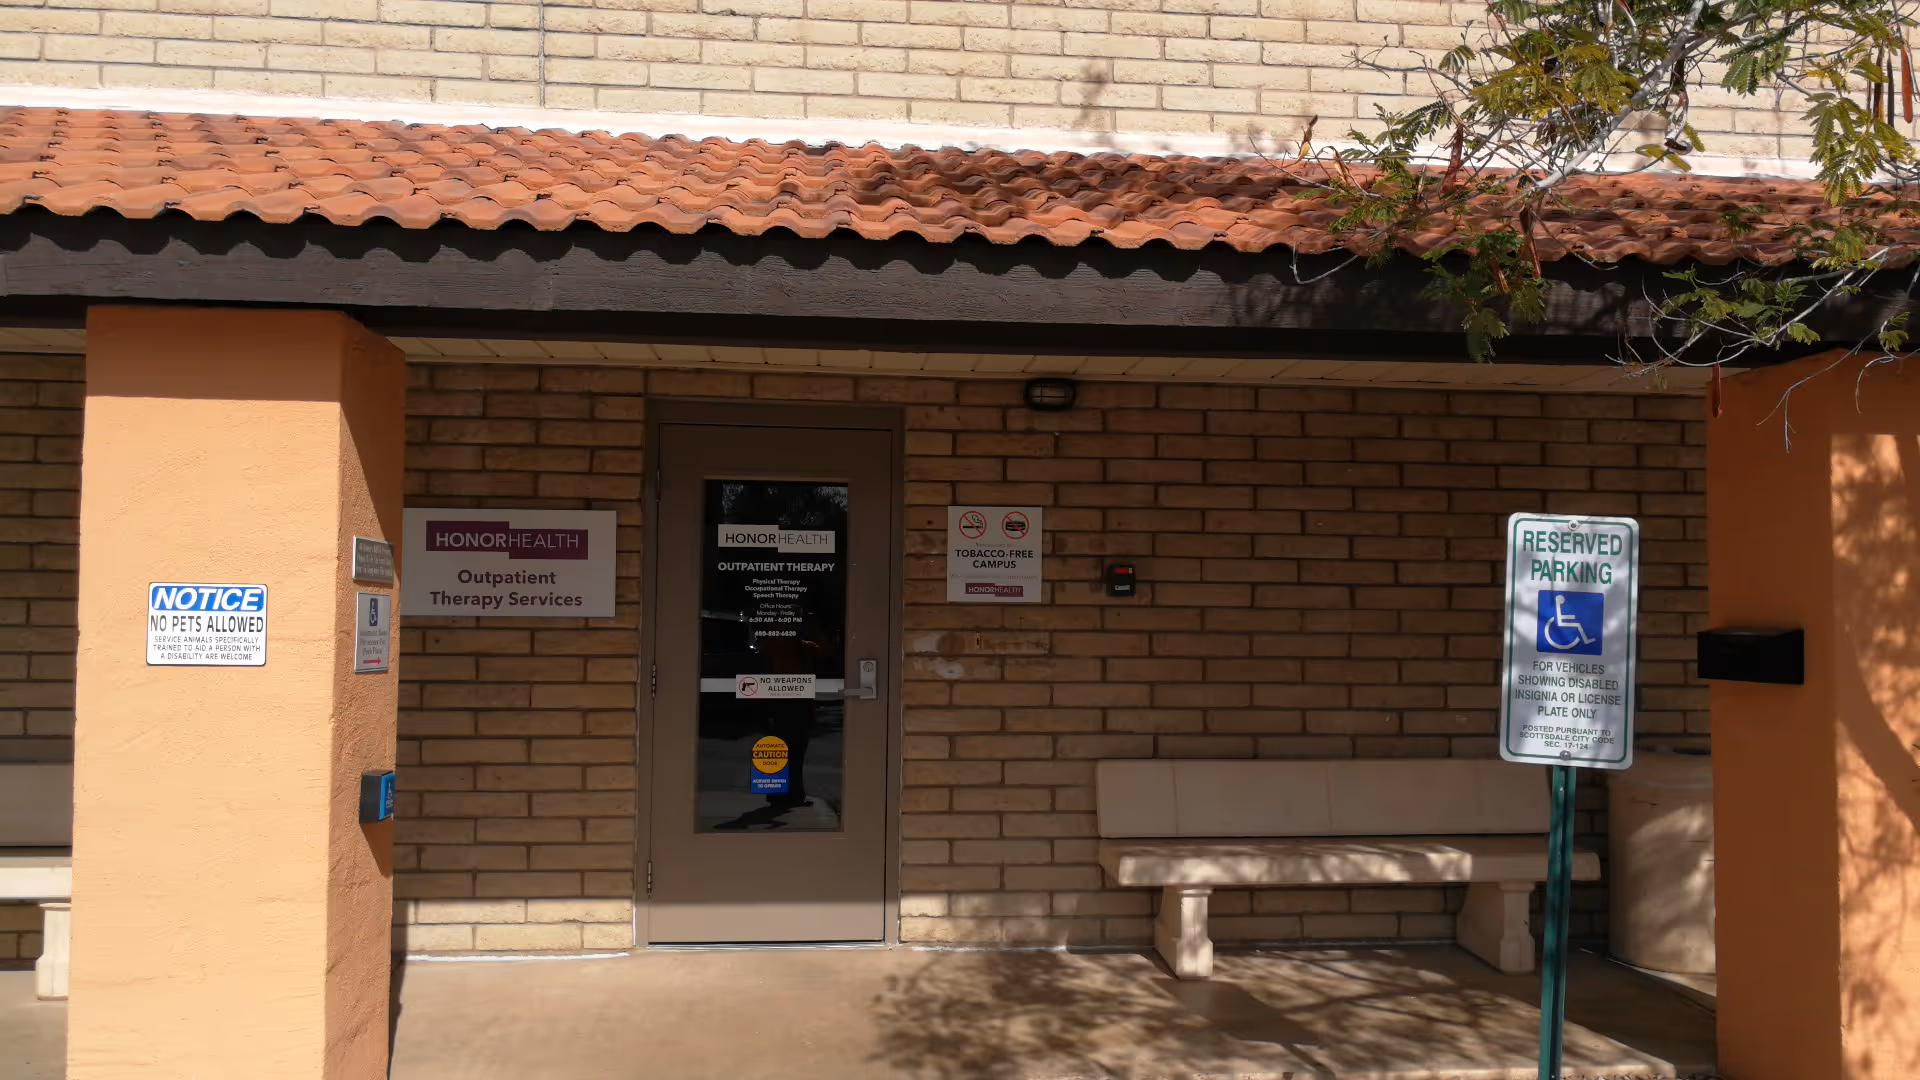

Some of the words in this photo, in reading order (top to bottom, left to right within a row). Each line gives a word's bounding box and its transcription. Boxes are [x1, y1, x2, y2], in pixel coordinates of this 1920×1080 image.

[436, 532, 579, 548] HONORHEALTH
[725, 533, 828, 545] HONORHEALTH
[1523, 530, 1622, 555] RESERVED
[955, 549, 1034, 559] TOBACCO-FREE
[718, 562, 785, 572] OUTPATIENT
[786, 562, 835, 572] THERAPY
[972, 560, 1017, 569] CAMPUS
[1531, 559, 1612, 584] PARKING
[457, 569, 557, 588] Outpatient
[153, 587, 262, 610] NOTICE
[430, 591, 504, 609] Therapy
[508, 592, 583, 606] Services
[150, 615, 167, 632] NO
[172, 616, 202, 632] PETS
[206, 616, 264, 633] ALLOWED
[1533, 661, 1553, 672] FOR
[1555, 662, 1605, 674] VEHICLES
[1518, 675, 1565, 687] SHOWING
[1568, 678, 1619, 690] DISABLED
[1515, 689, 1558, 702] INSIGNIA
[1560, 692, 1575, 703] OR
[1578, 693, 1621, 705] LICENSE
[1537, 705, 1568, 717] PLATE
[1571, 707, 1597, 719] ONLY
[1519, 732, 1570, 741] SCOTTSDALE
[1572, 735, 1590, 743] CITY
[1592, 736, 1615, 744] CODE
[1522, 725, 1554, 733] POSTED
[1555, 726, 1598, 736] PURSUANT
[1600, 729, 1611, 737] TO
[1544, 740, 1561, 748] SEC.
[1564, 742, 1588, 750] 17-124
